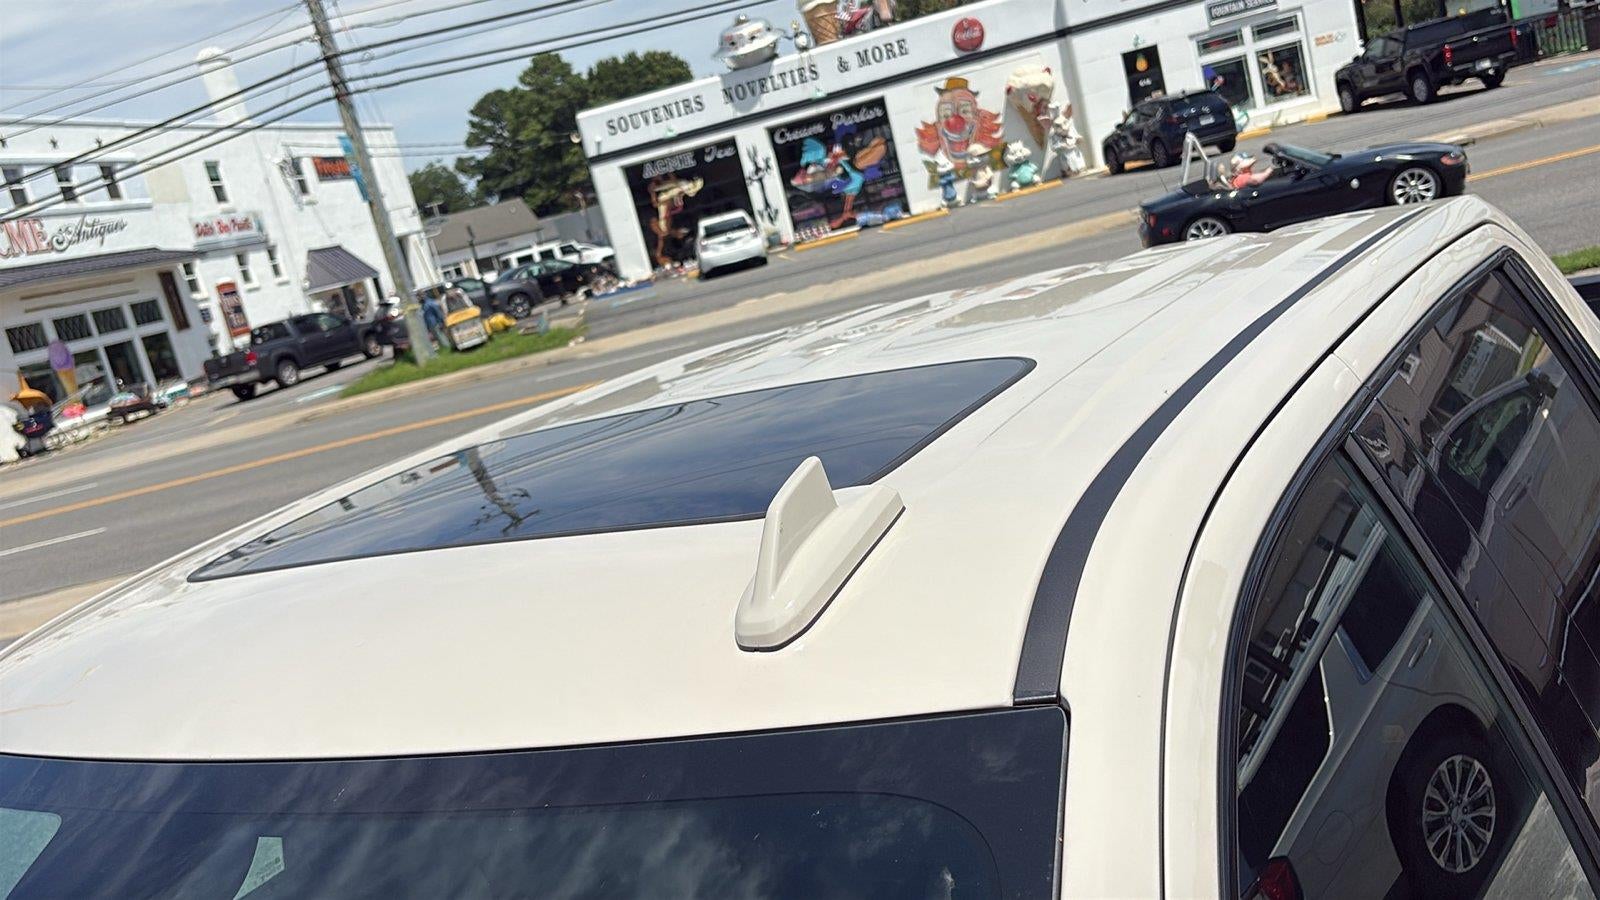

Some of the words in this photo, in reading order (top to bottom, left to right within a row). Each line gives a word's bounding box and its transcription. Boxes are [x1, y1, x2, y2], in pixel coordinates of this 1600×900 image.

[606, 95, 705, 136] SOUVENIRS
[722, 64, 820, 105] NOVELTIES
[837, 56, 851, 74] &
[856, 38, 909, 68] MORE
[643, 151, 697, 179] ACME
[704, 144, 736, 163] Ice
[68, 213, 128, 247] Antiques
